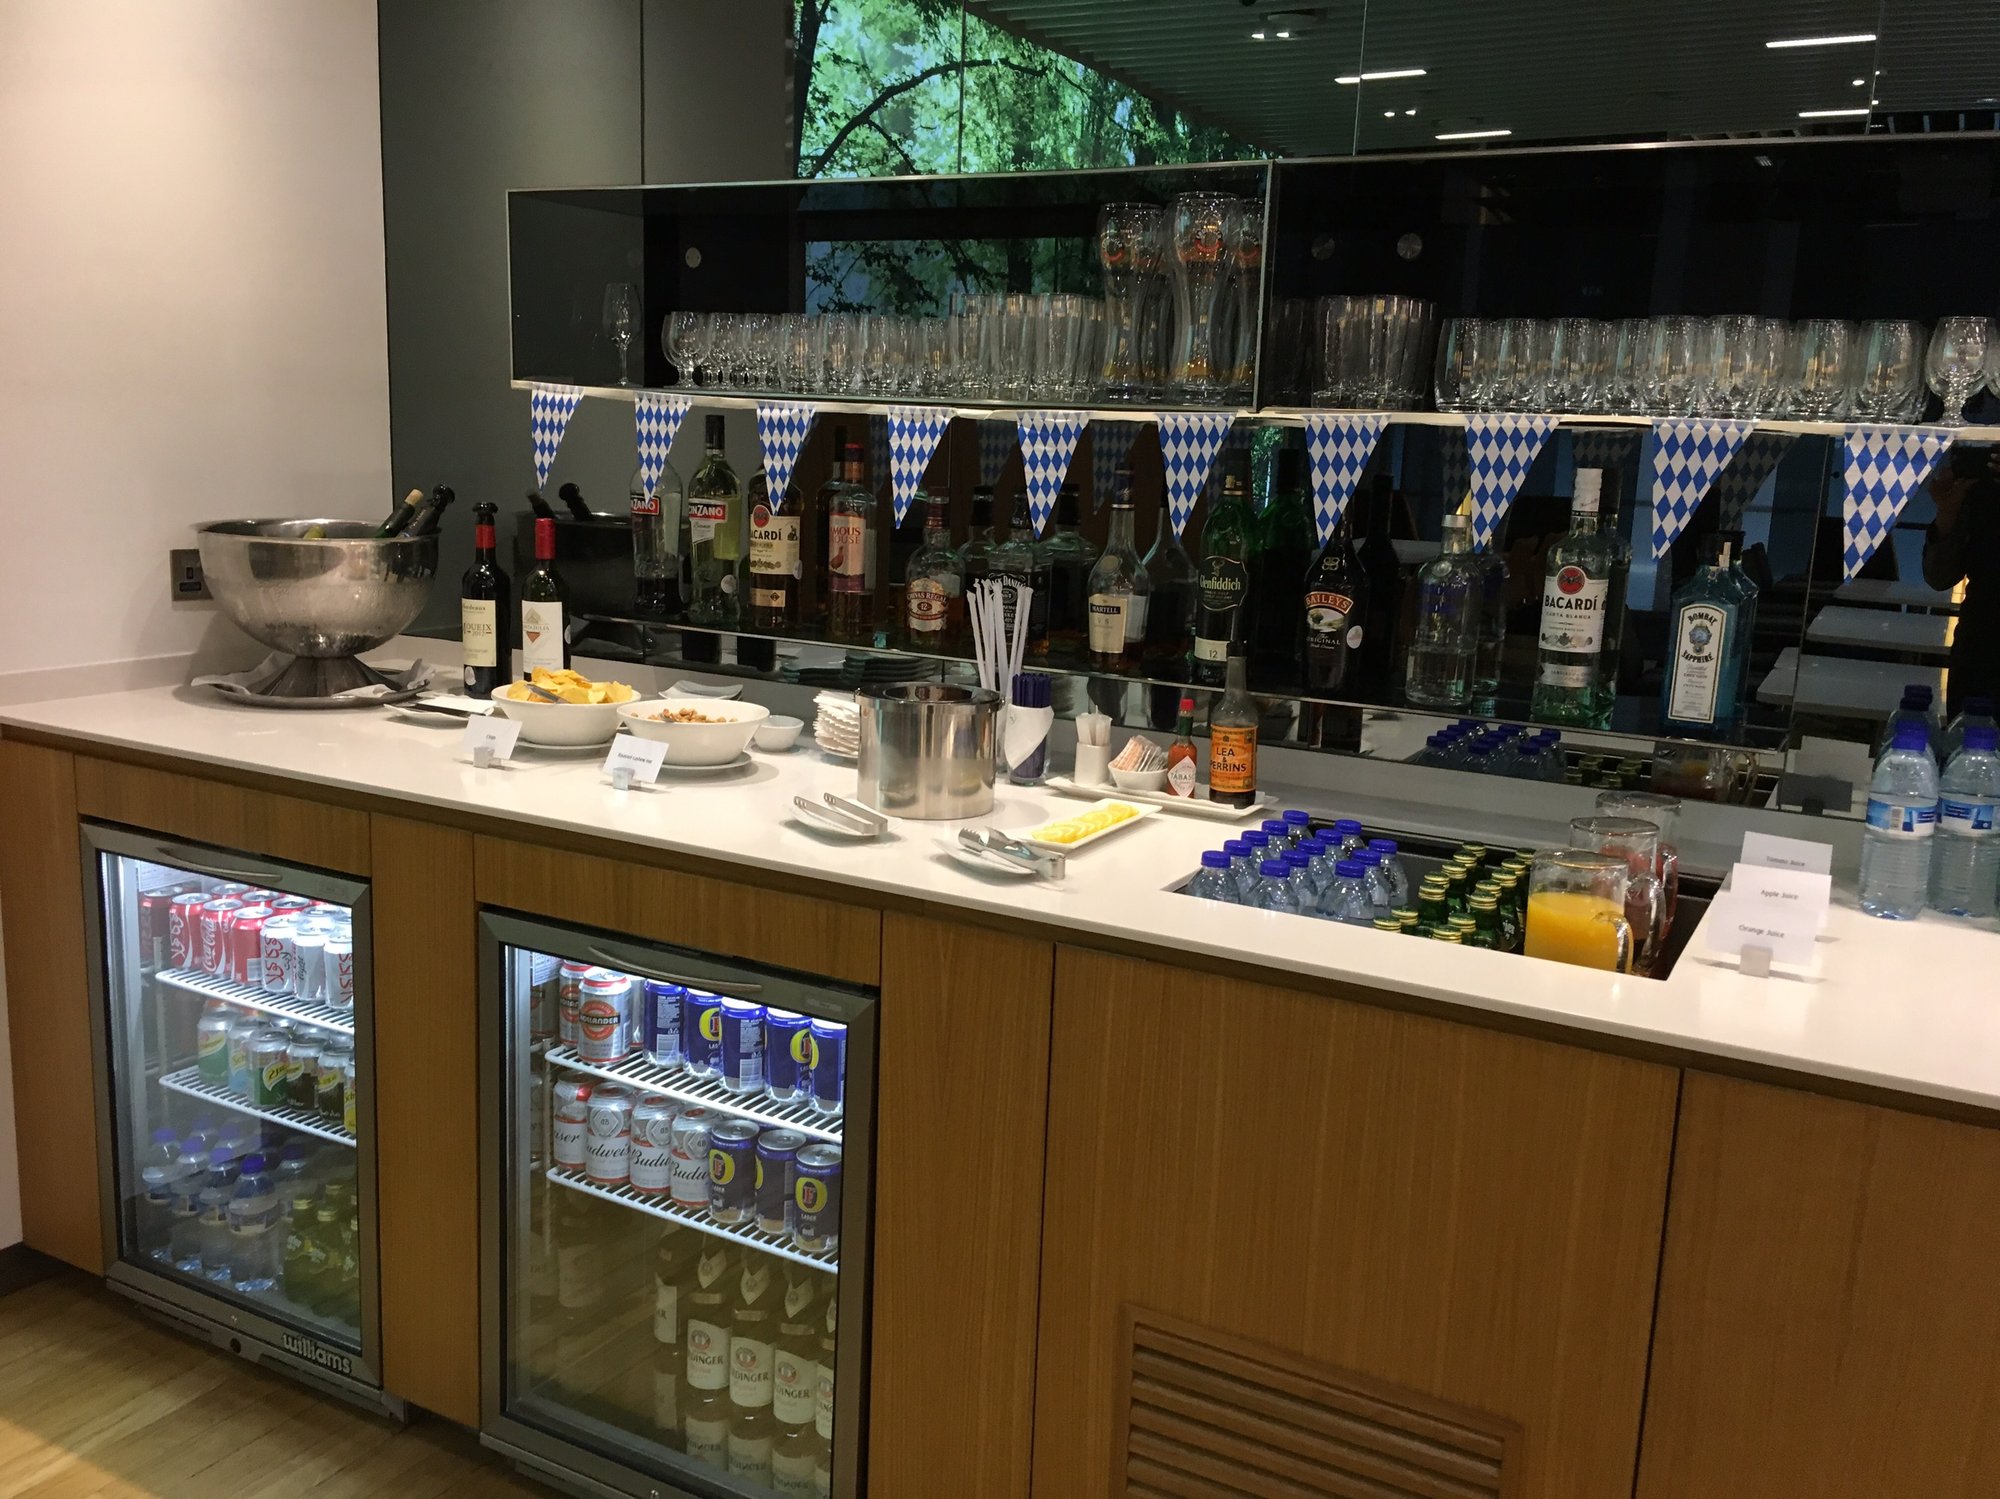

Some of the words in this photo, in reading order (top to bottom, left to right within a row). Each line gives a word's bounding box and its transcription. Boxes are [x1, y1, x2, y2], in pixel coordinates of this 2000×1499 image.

[1200, 575, 1240, 590] Glenfiddich
[1306, 594, 1350, 608] BAILEYS
[1544, 595, 1597, 611] BACARDÍ
[1091, 606, 1119, 614] MARTELL
[1687, 612, 1718, 626] BOMBAY
[1209, 650, 1218, 658] 12
[1681, 650, 1714, 663] SAPPHIRE
[1216, 747, 1235, 757] LEA
[1209, 759, 1247, 772] PERRINS
[1761, 889, 1780, 898] Apple
[1781, 892, 1798, 900] Juice
[1739, 924, 1764, 935] Orange
[1766, 929, 1784, 938] Juice
[283, 1334, 351, 1374] williams
